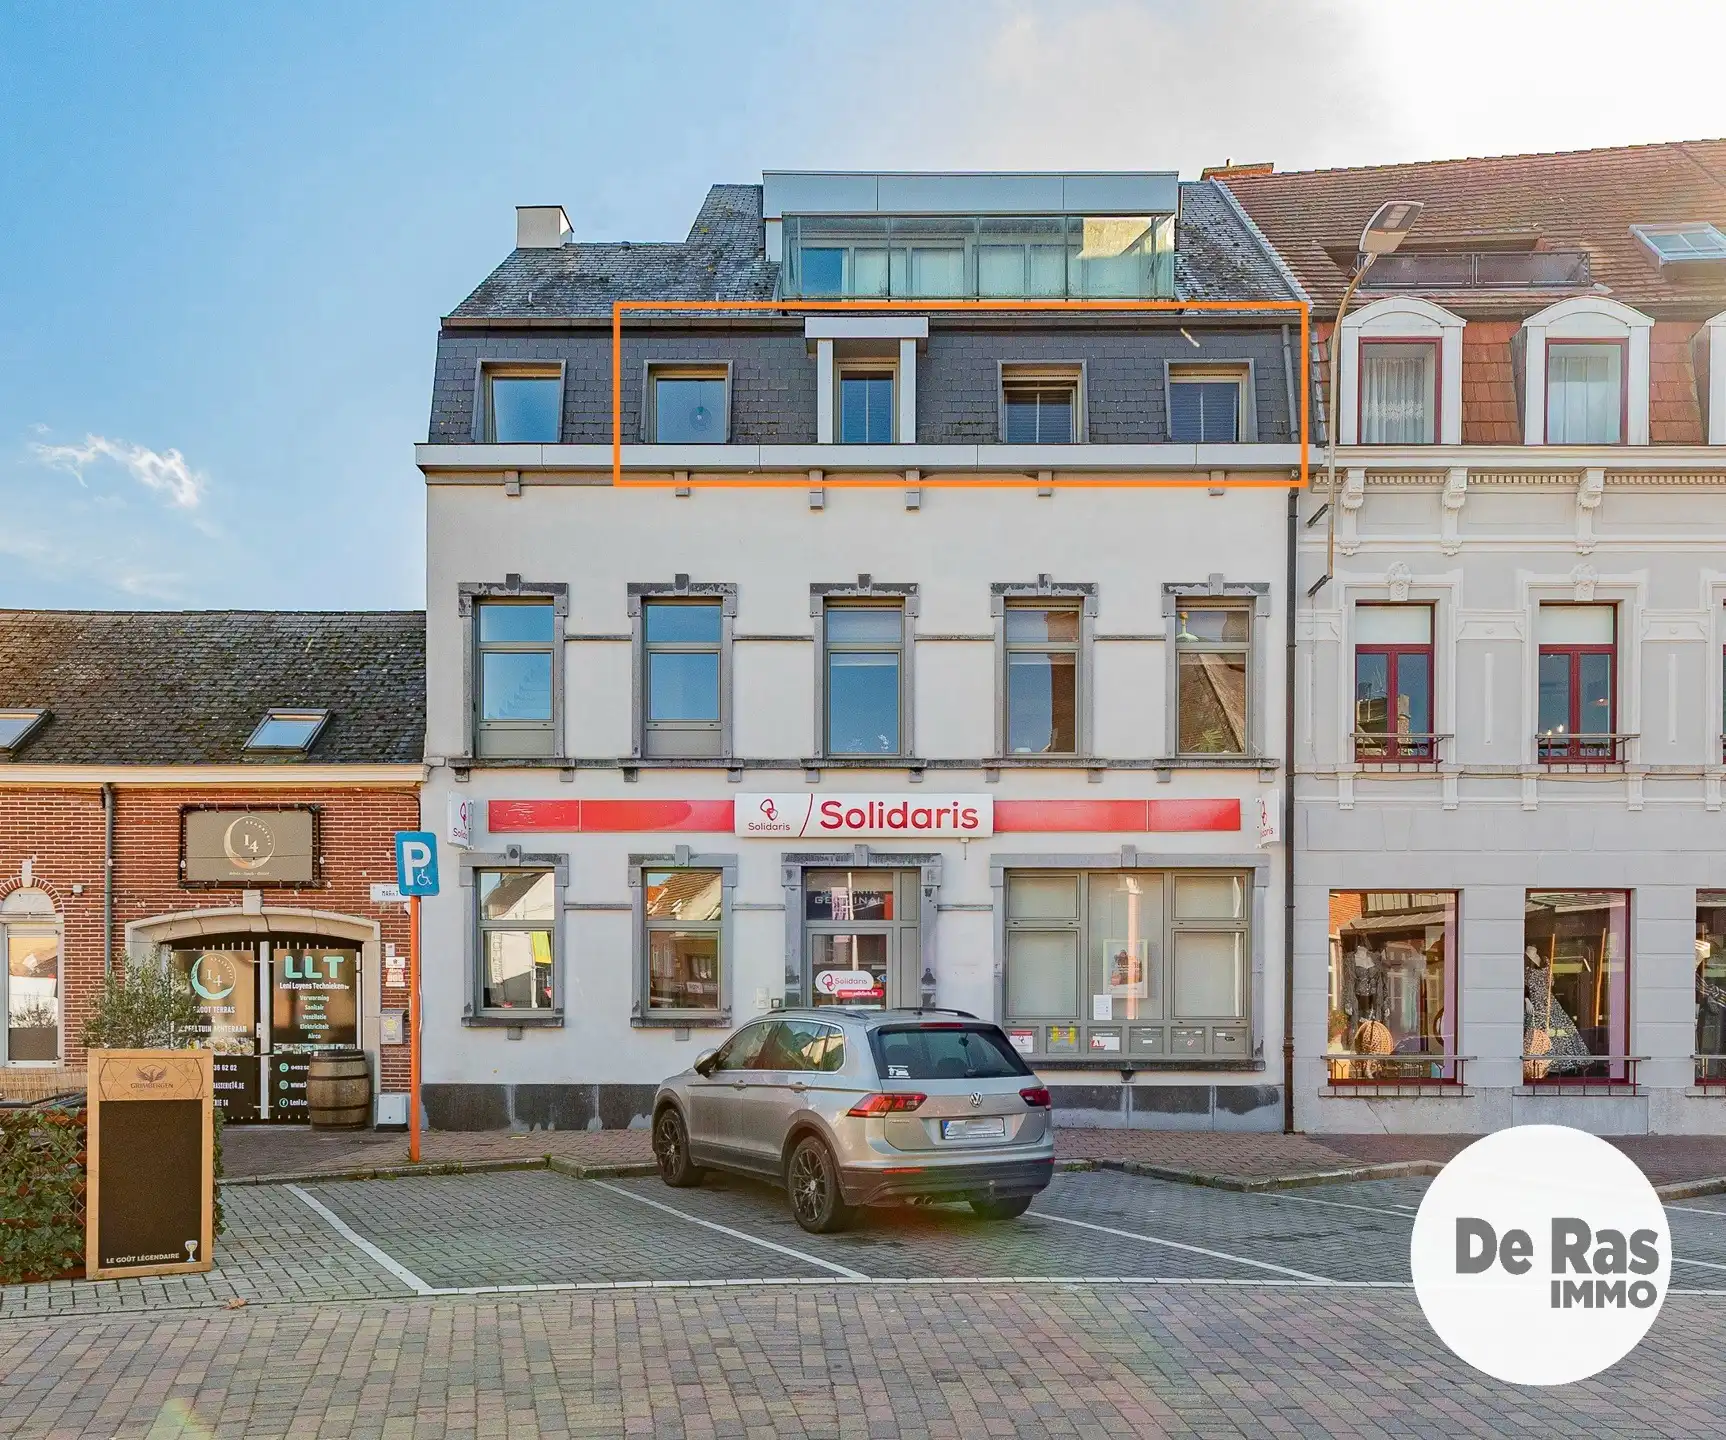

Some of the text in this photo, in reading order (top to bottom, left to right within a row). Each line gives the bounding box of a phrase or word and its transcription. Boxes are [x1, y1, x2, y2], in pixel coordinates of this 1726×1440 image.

[820, 800, 979, 829] Solidaris
[748, 822, 791, 831] Solidaris
[244, 834, 259, 853] 14
[402, 841, 431, 886] P
[814, 896, 885, 904] GEINAL
[285, 955, 345, 979] LLT
[834, 977, 868, 985] Solidaris
[279, 982, 292, 990] Leni
[292, 982, 312, 991] Loyens
[312, 982, 345, 990] Technieken
[213, 1006, 235, 1014] TERRAS
[116, 1255, 136, 1263] GOÛT
[137, 1252, 180, 1262] LÉGENDAIRE
